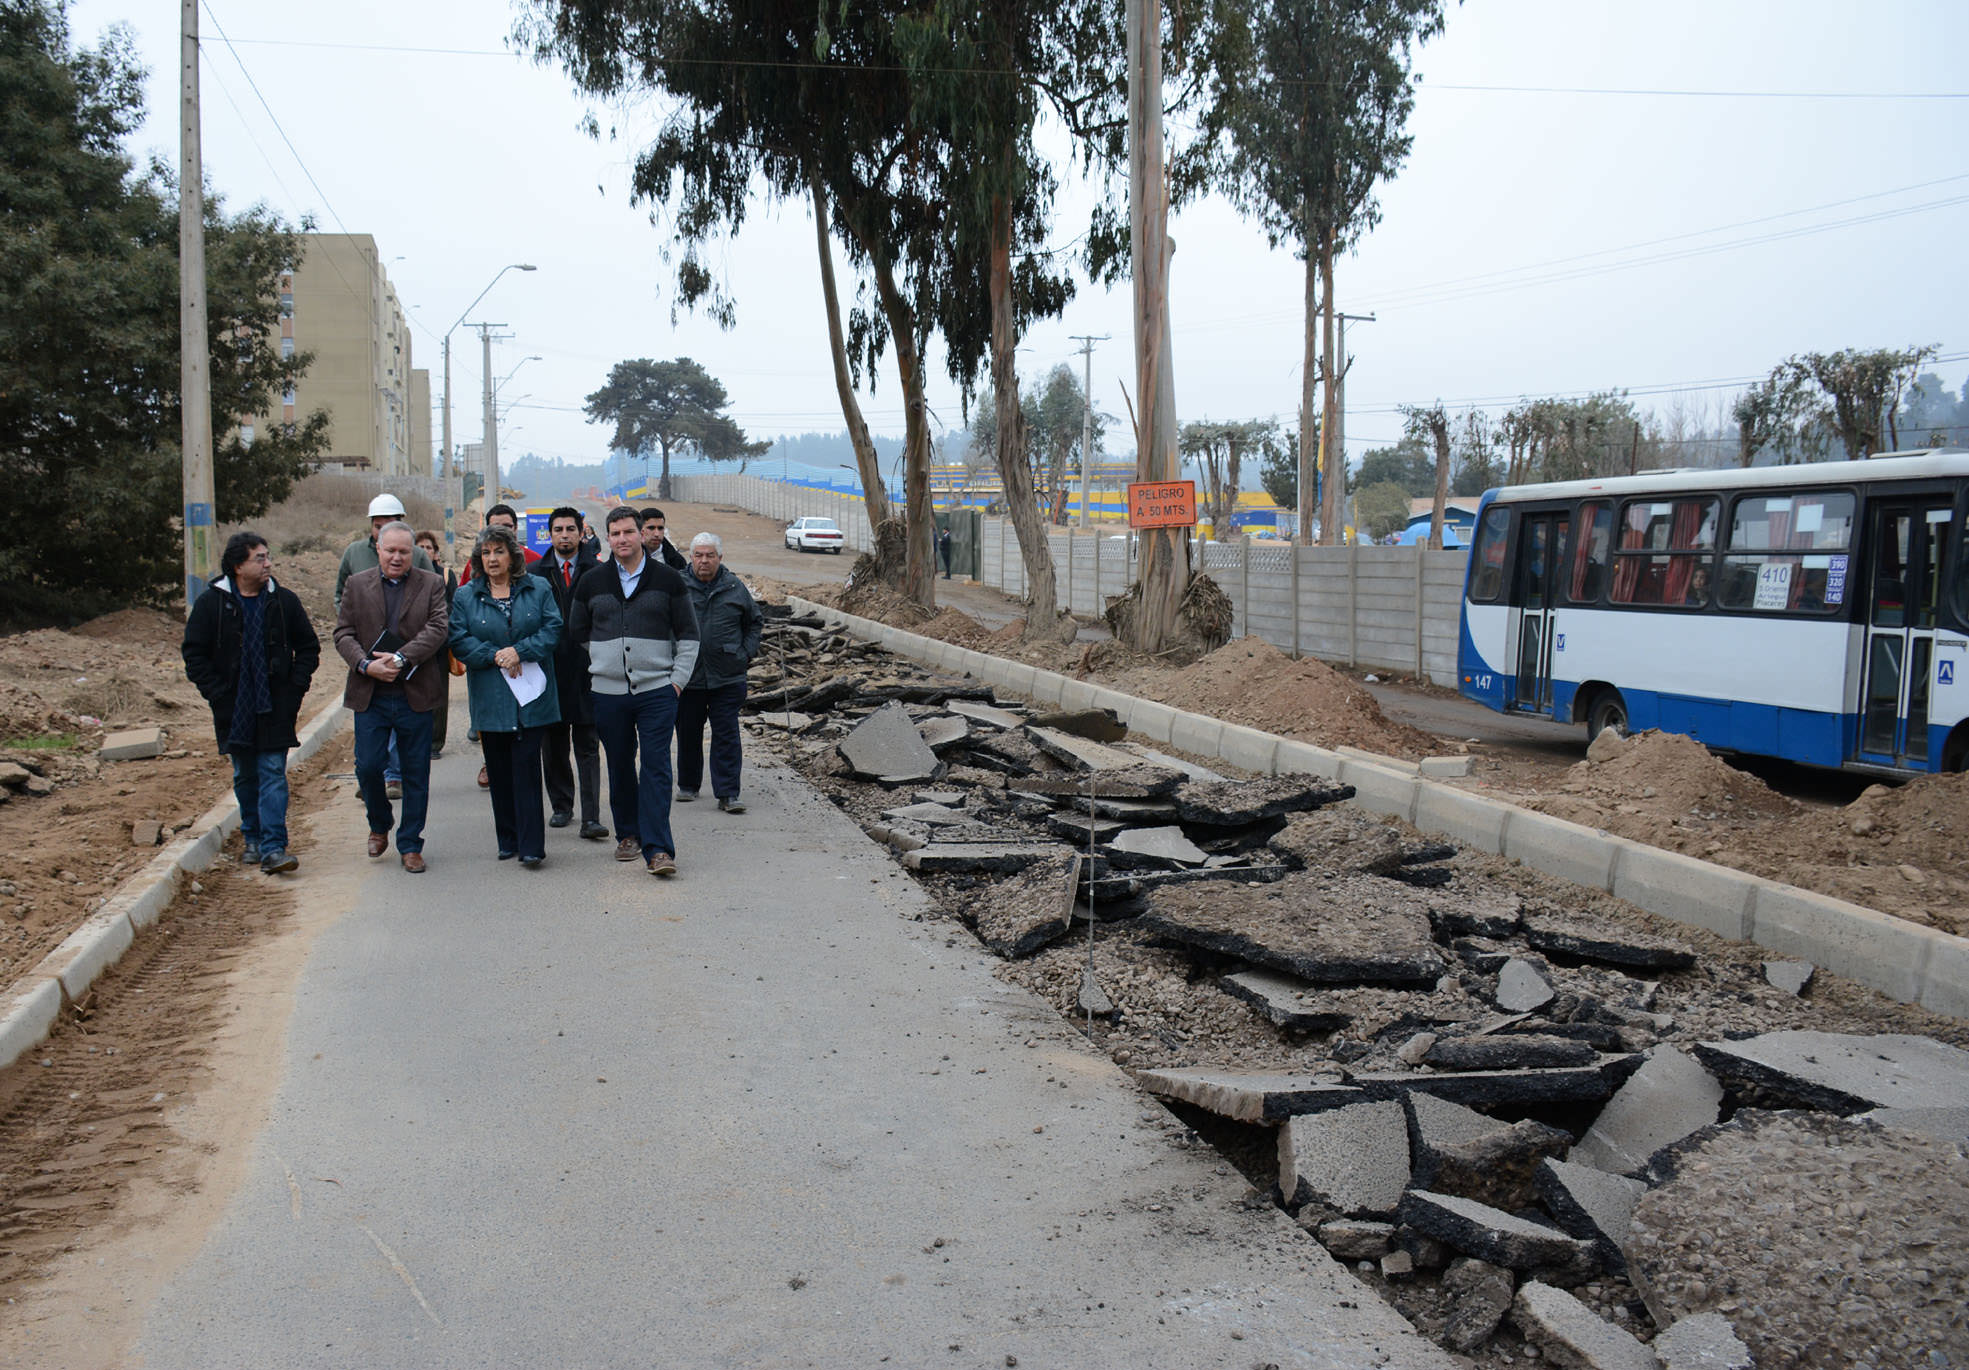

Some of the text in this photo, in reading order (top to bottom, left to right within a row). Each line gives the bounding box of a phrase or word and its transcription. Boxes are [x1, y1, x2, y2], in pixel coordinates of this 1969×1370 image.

[1138, 487, 1185, 500] PELIGRO
[1136, 506, 1145, 517] A
[1149, 505, 1161, 517] 50
[1761, 567, 1788, 583] 410
[1475, 674, 1492, 690] 147
